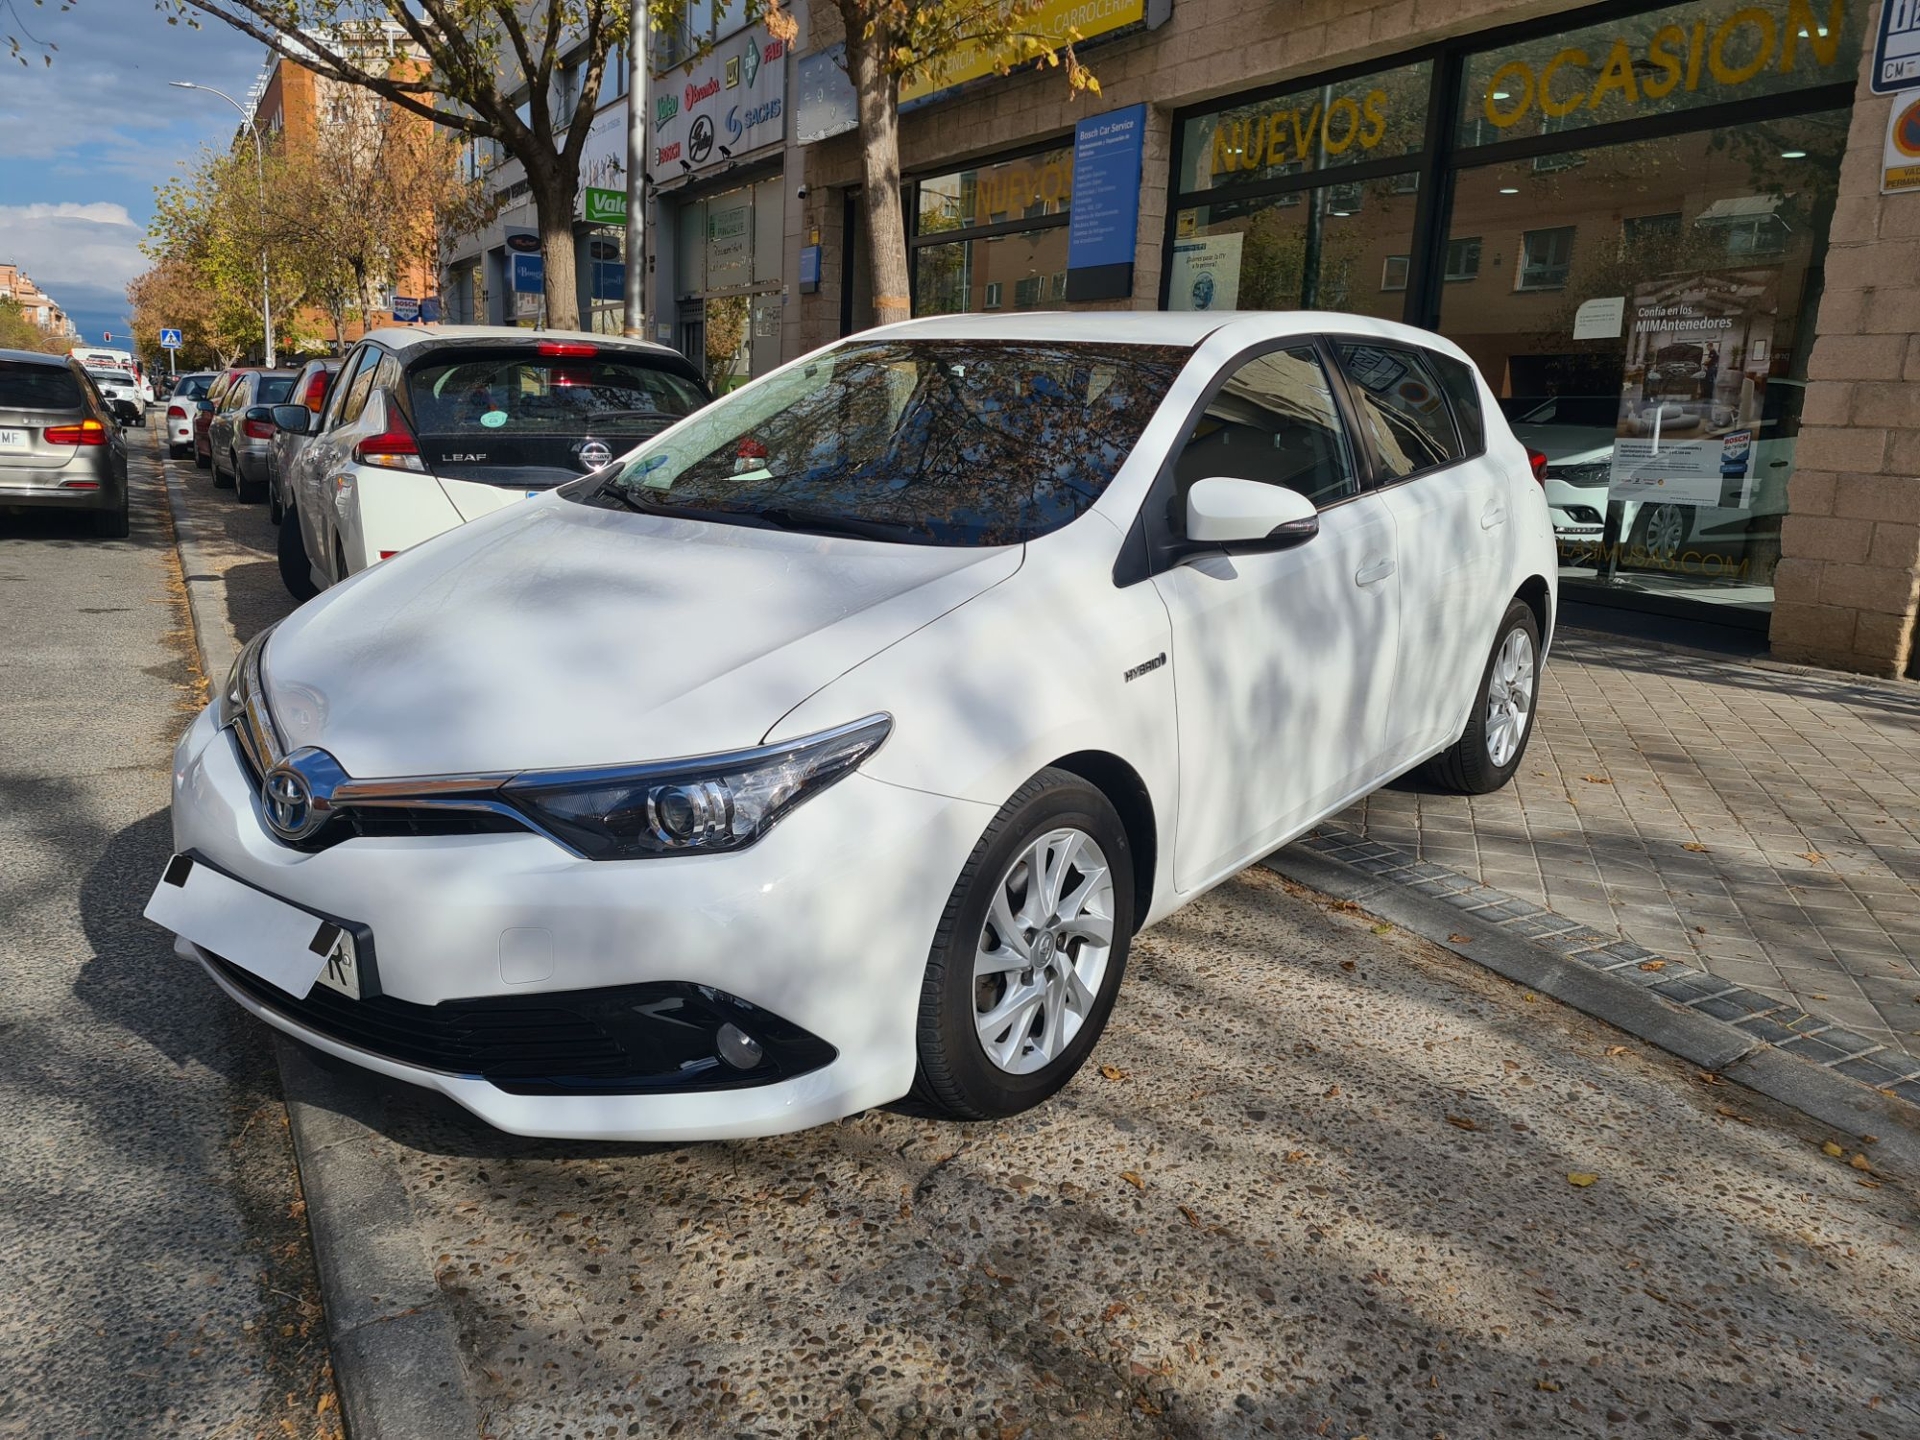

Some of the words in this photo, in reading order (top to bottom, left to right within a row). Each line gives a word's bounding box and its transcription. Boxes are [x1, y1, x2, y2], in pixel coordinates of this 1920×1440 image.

[763, 40, 783, 65] FAG
[1485, 0, 1843, 128] OCASION
[744, 98, 781, 129] SACHS
[1080, 128, 1099, 141] Bosch
[1099, 126, 1110, 136] Car
[1111, 120, 1134, 133] Service
[1211, 88, 1388, 175] NUEVOS
[660, 142, 681, 164] BOSCH
[593, 193, 627, 213] Vale
[395, 299, 418, 308] BOSCH
[1638, 305, 1666, 318] Confía
[1667, 307, 1678, 316] en
[1679, 304, 1693, 315] los
[1635, 315, 1733, 333] MIMAntenedores
[1724, 434, 1749, 445] BOSCH
[441, 453, 488, 462] LEAF
[1123, 656, 1162, 683] HYBRID
